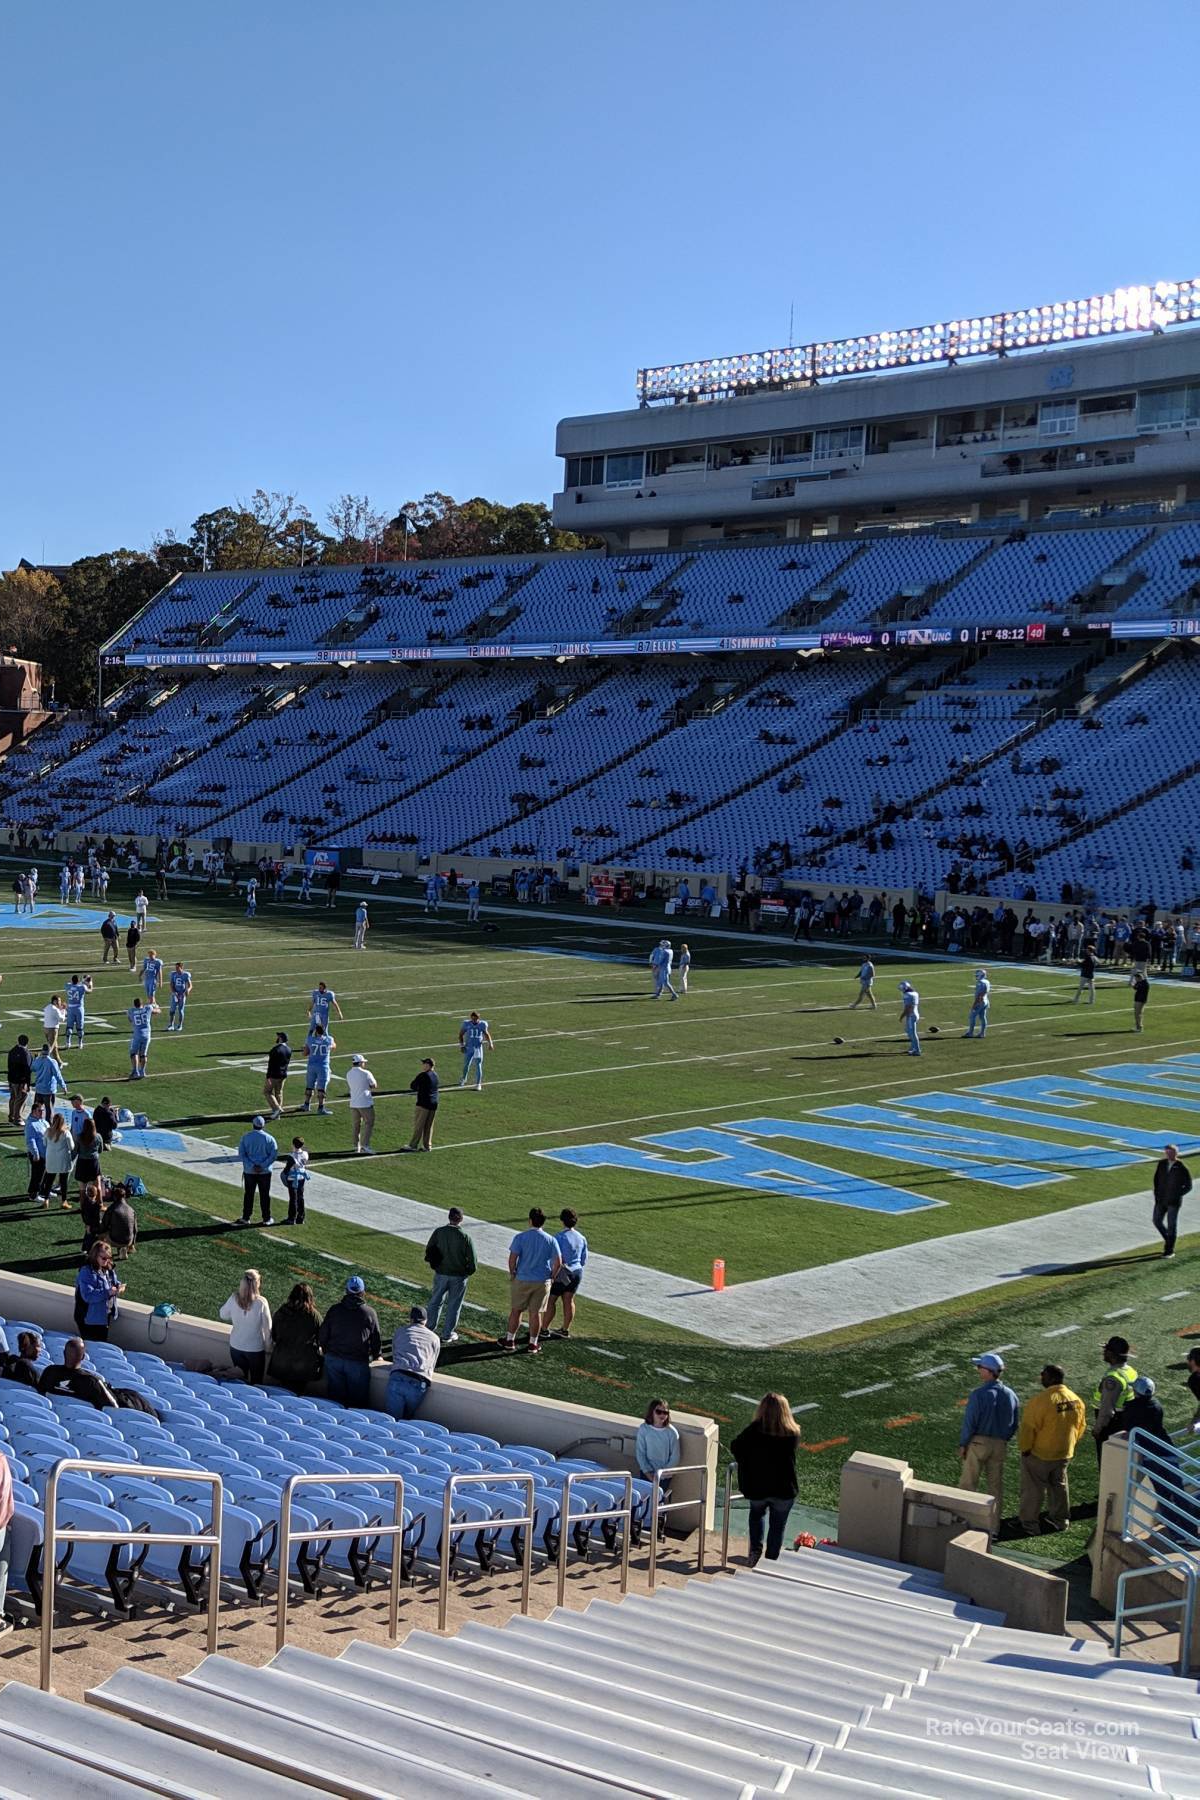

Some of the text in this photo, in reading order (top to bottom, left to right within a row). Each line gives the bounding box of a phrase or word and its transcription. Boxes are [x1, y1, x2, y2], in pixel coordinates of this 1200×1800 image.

[1170, 621, 1184, 633] 31
[852, 635, 872, 644] WCU
[881, 632, 890, 645] 0
[932, 632, 951, 641] UNC
[960, 629, 969, 642] 0
[995, 629, 1024, 640] 48:12
[1030, 628, 1042, 638] 40
[564, 643, 590, 654] JONES
[638, 640, 677, 651] 87 ELLIS
[732, 637, 776, 649] SIMMONS
[317, 650, 356, 661] 98 TAYLOR
[391, 648, 431, 659] 95 FULLER
[469, 645, 511, 657] 12 HORTON
[104, 656, 121, 665] 2:16
[146, 652, 257, 664] WELCOME TO KENAN STADIUM
[145, 962, 155, 972] 15
[175, 977, 182, 987] 6
[67, 990, 80, 1002] 54
[316, 995, 327, 1007] 16
[469, 1028, 480, 1038] 11
[311, 1043, 328, 1056] 70
